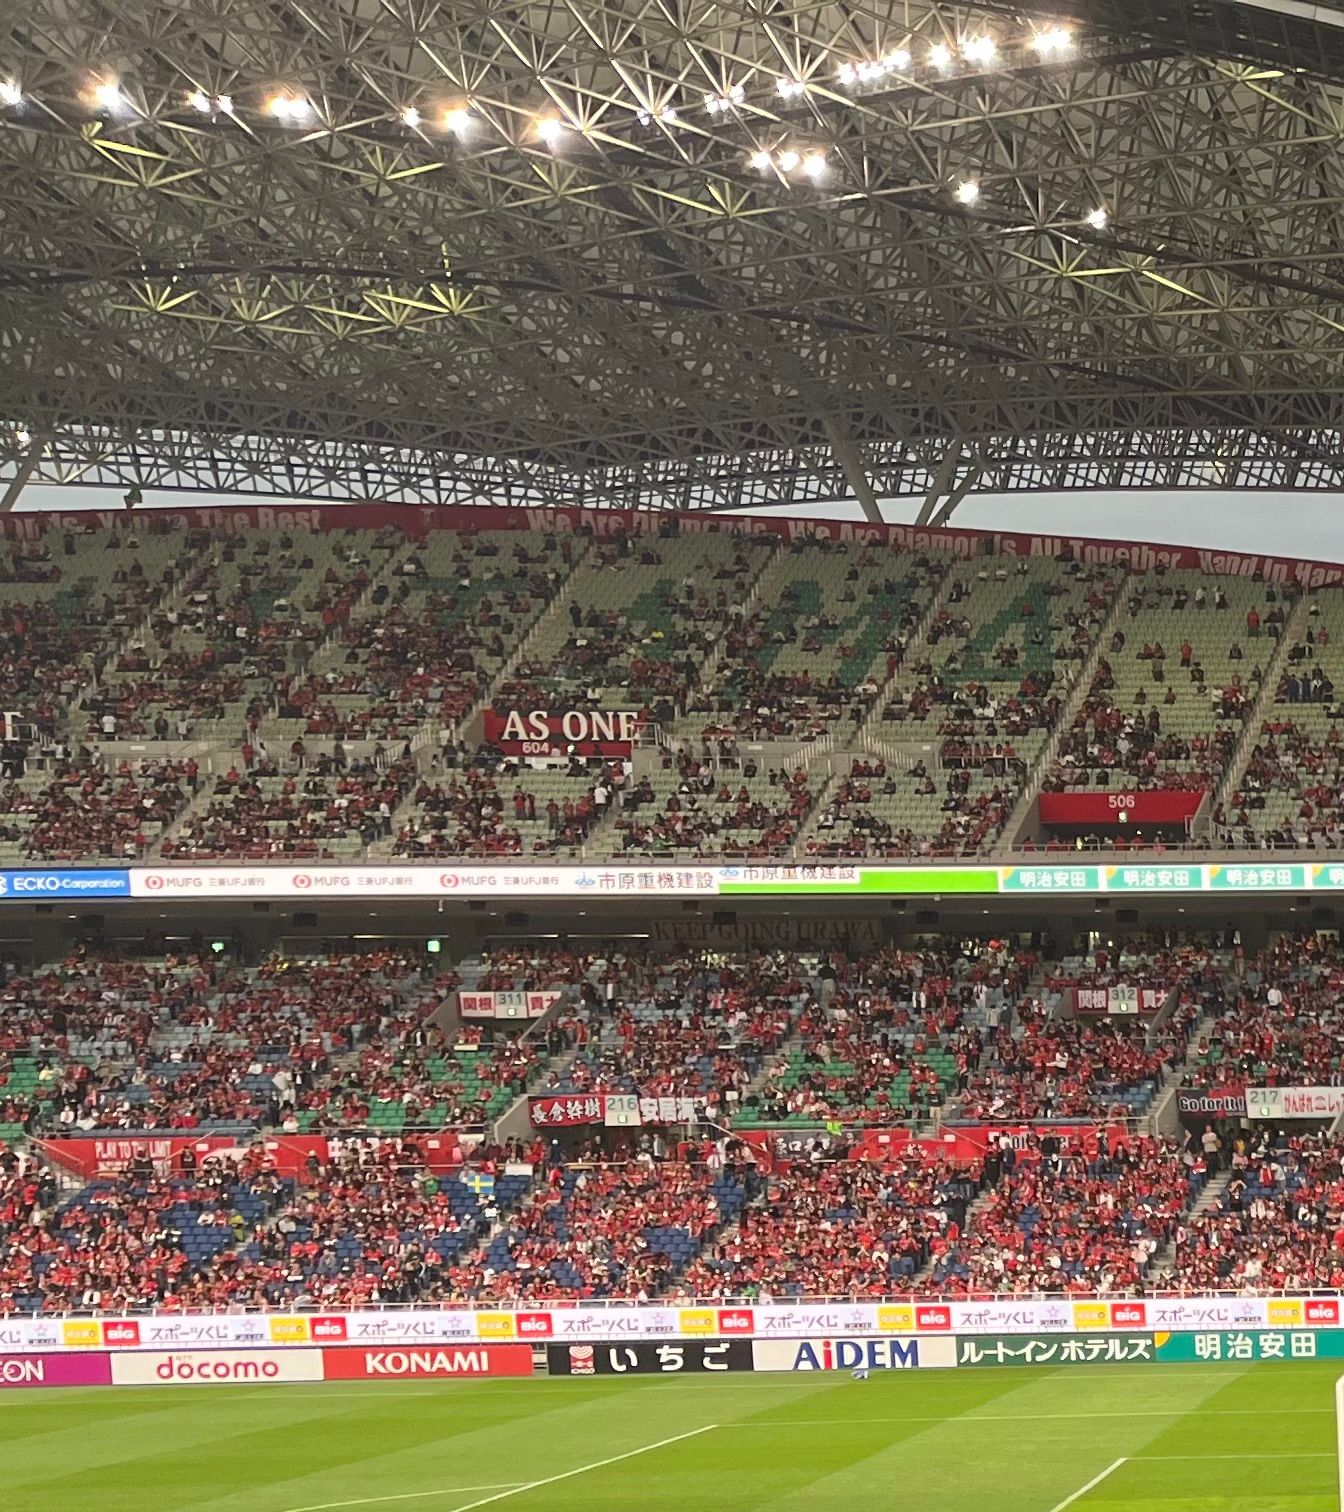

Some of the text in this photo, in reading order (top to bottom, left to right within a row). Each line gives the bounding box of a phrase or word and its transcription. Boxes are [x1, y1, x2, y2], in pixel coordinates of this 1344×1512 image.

[501, 710, 638, 741] AS ONE
[522, 742, 549, 754] 604
[1108, 795, 1135, 809] 506
[166, 877, 203, 889] MUFG
[314, 876, 351, 888] MUFG
[461, 875, 497, 886] MUFG
[598, 872, 714, 890] 市原重機建設
[1019, 870, 1087, 888] 明治安田
[1123, 869, 1190, 887] 明治安田
[1226, 868, 1292, 886] 明治安田
[499, 994, 522, 1006] 311
[1111, 989, 1135, 1000] 312
[607, 1096, 637, 1111] 216
[1250, 1090, 1279, 1103] 217
[95, 1141, 117, 1159] PLAY
[920, 1310, 945, 1325] BIG
[960, 1311, 1034, 1326] スポーツくじ
[1115, 1308, 1140, 1321] BIG
[1155, 1307, 1229, 1322] スポーツくじ
[1309, 1305, 1334, 1319] BIG
[315, 1320, 341, 1336] BIG
[357, 1320, 435, 1337] スポーツくじ
[521, 1317, 547, 1332] BIG
[563, 1316, 638, 1332] スポーツくじ
[722, 1313, 748, 1329] BIG
[764, 1313, 838, 1329] スポーツくじ
[107, 1324, 134, 1340] BIG
[150, 1324, 229, 1341] スポーツくじ
[959, 1339, 1152, 1364] ルートインホテルズ
[1194, 1331, 1316, 1360] 明治安田
[365, 1351, 489, 1374] KONAMI
[609, 1342, 730, 1372] いちご
[792, 1340, 919, 1371] AiDEM
[156, 1356, 279, 1380] docomo
